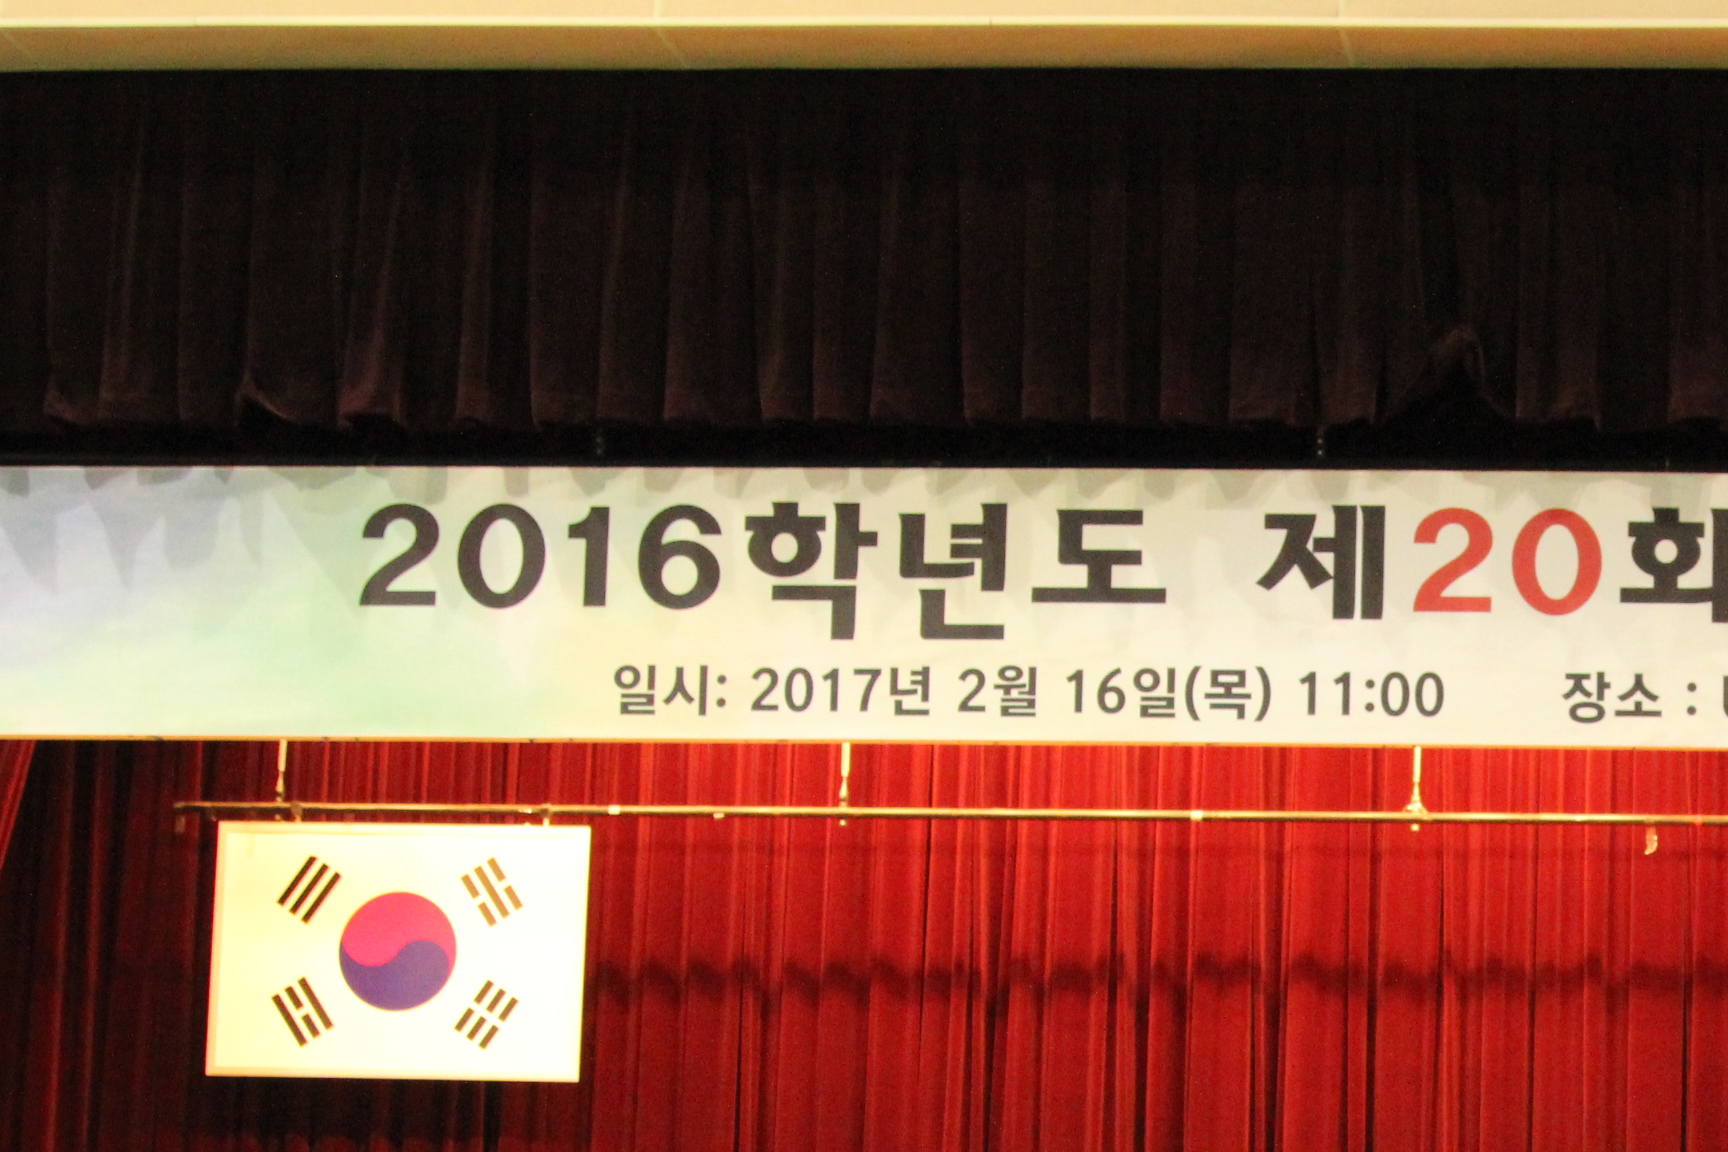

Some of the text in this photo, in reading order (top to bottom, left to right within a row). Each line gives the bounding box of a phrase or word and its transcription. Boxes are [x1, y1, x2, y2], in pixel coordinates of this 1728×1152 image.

[359, 501, 1167, 641] 2016학년도
[613, 664, 1446, 724] 일시: 2017년 2월 16일(목) 11:00
